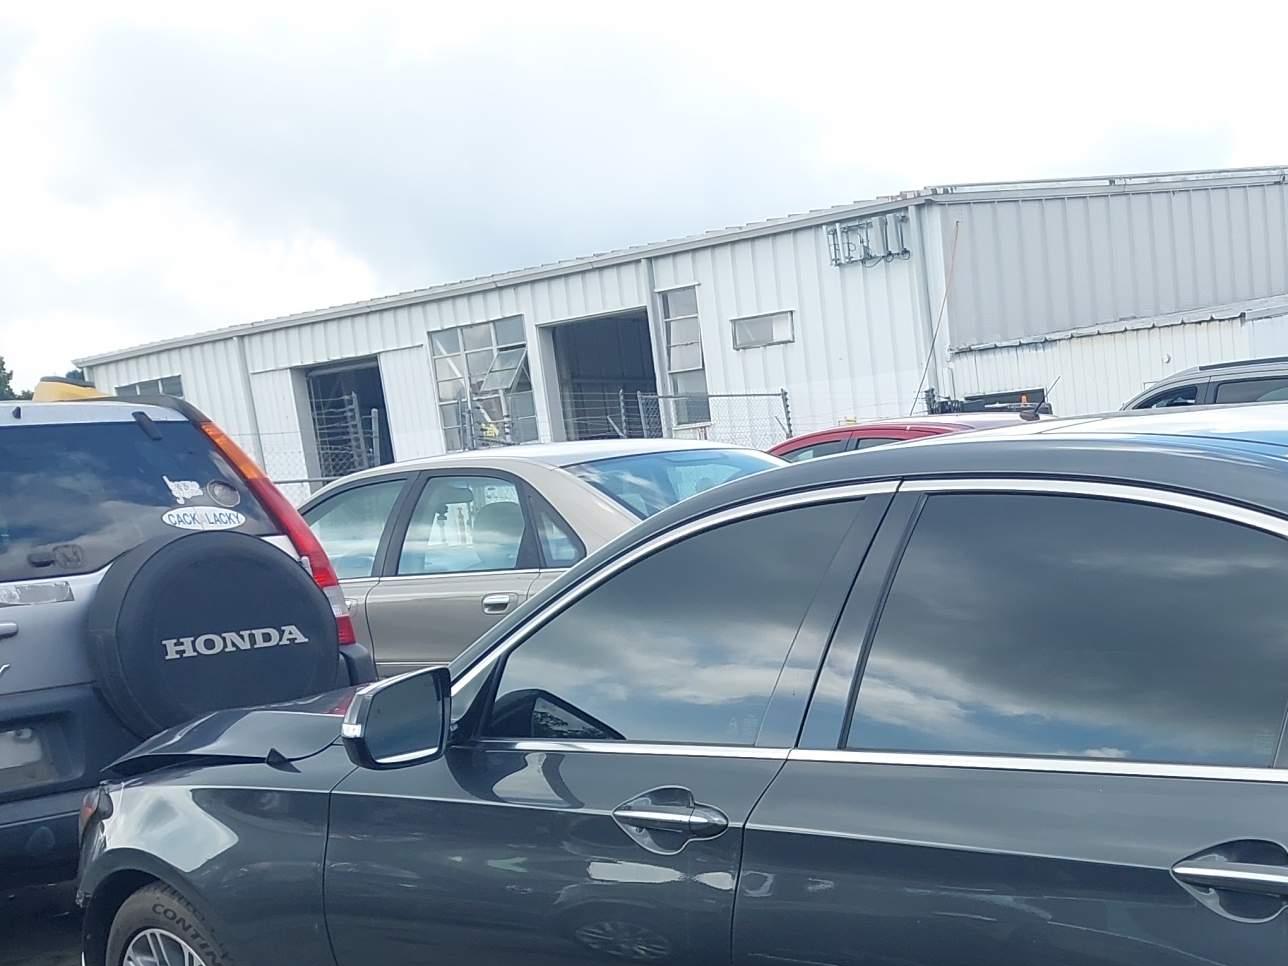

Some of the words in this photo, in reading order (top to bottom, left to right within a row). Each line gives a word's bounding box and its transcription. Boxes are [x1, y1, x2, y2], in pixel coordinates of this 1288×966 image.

[167, 512, 201, 526] CACK
[205, 511, 241, 525] LACKY
[161, 624, 310, 660] HONDA
